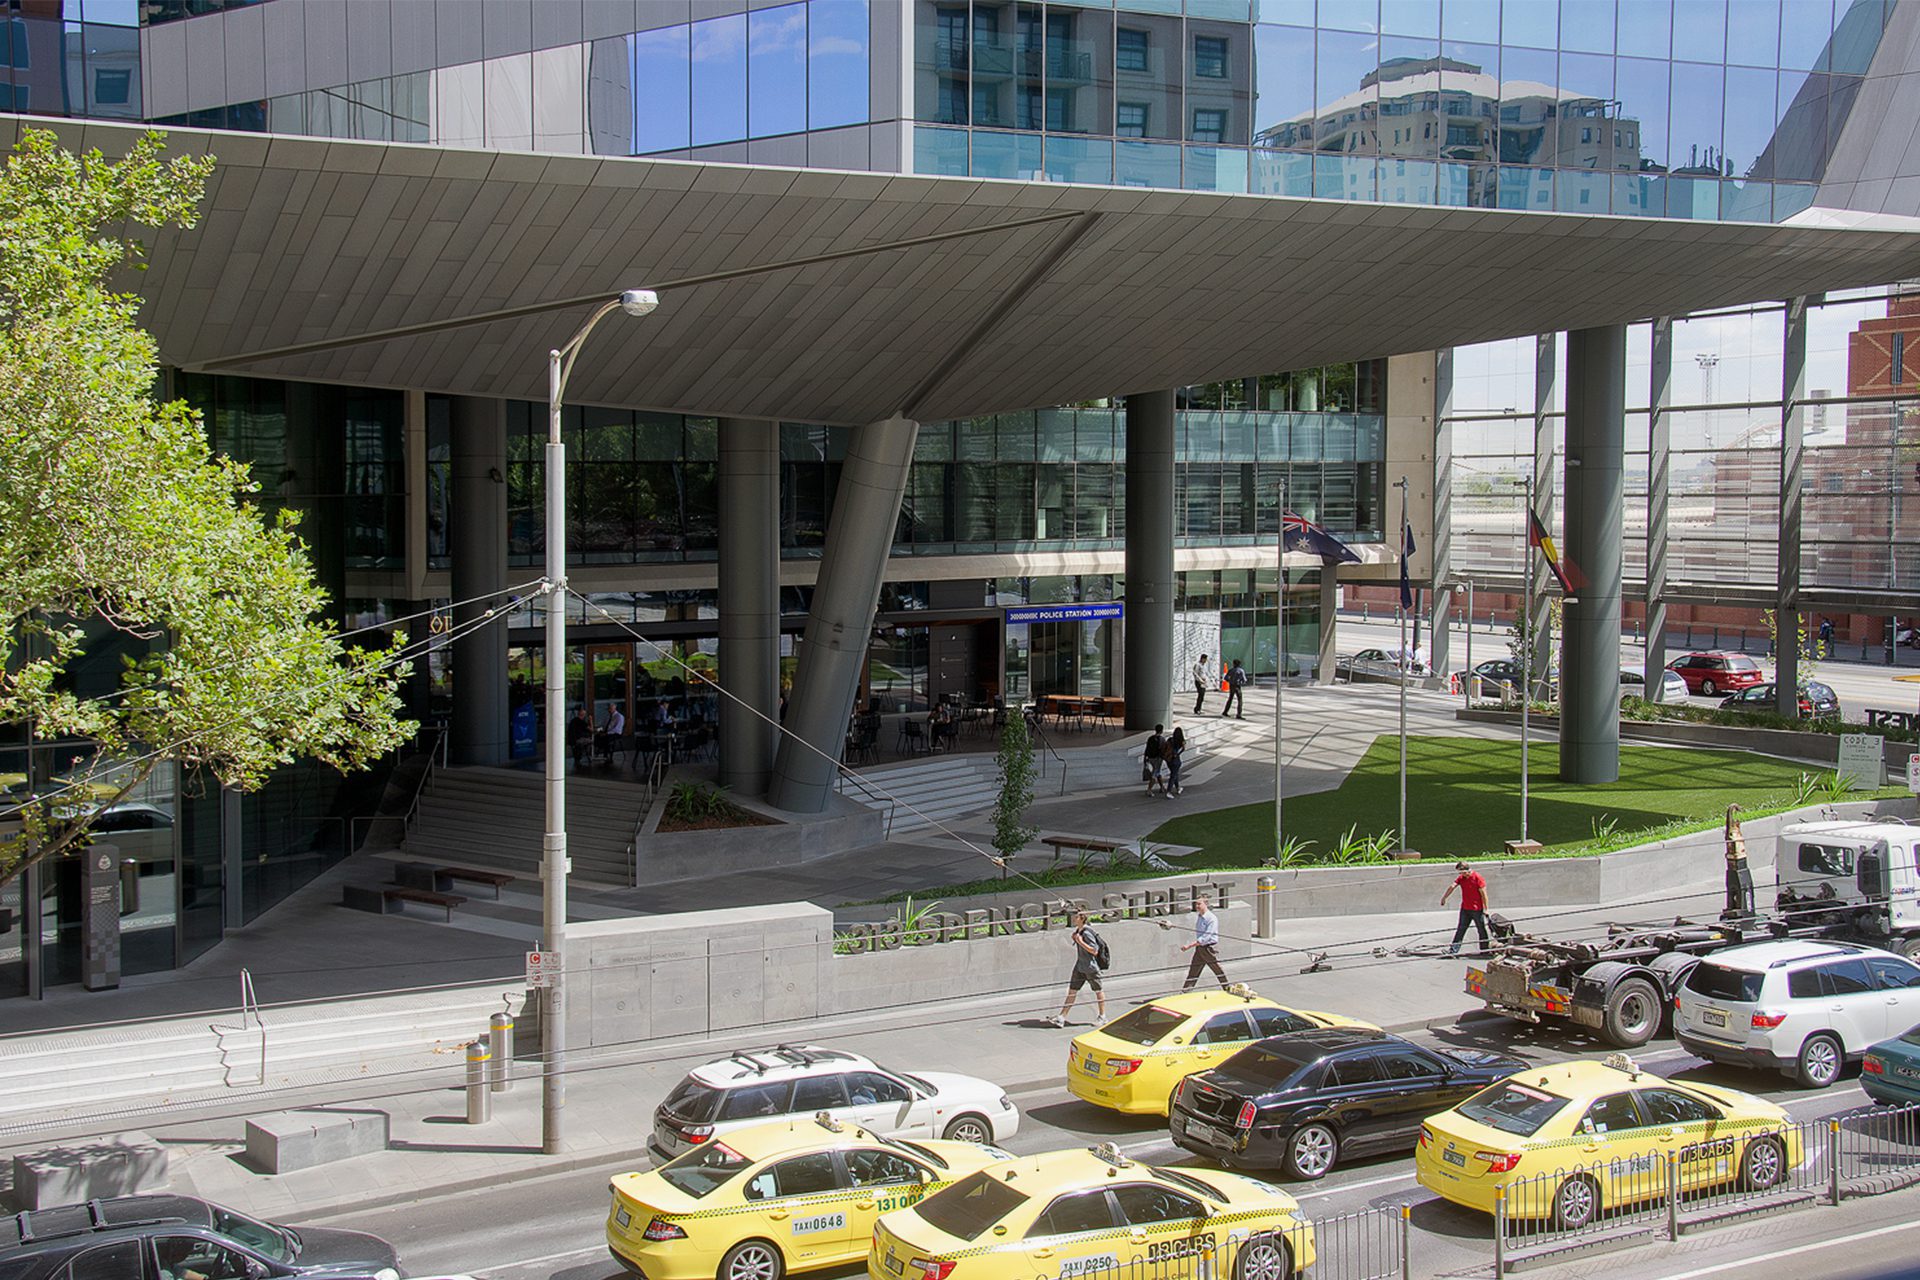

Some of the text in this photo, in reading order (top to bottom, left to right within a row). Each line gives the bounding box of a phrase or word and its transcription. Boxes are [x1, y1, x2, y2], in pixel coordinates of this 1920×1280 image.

[1040, 609, 1092, 619] POLICE STATION
[1843, 736, 1880, 745] CODE 3
[848, 919, 904, 955] 313
[1101, 882, 1235, 922] STREET
[876, 1199, 896, 1212] 131
[1064, 1256, 1112, 1272] TAXI 0250
